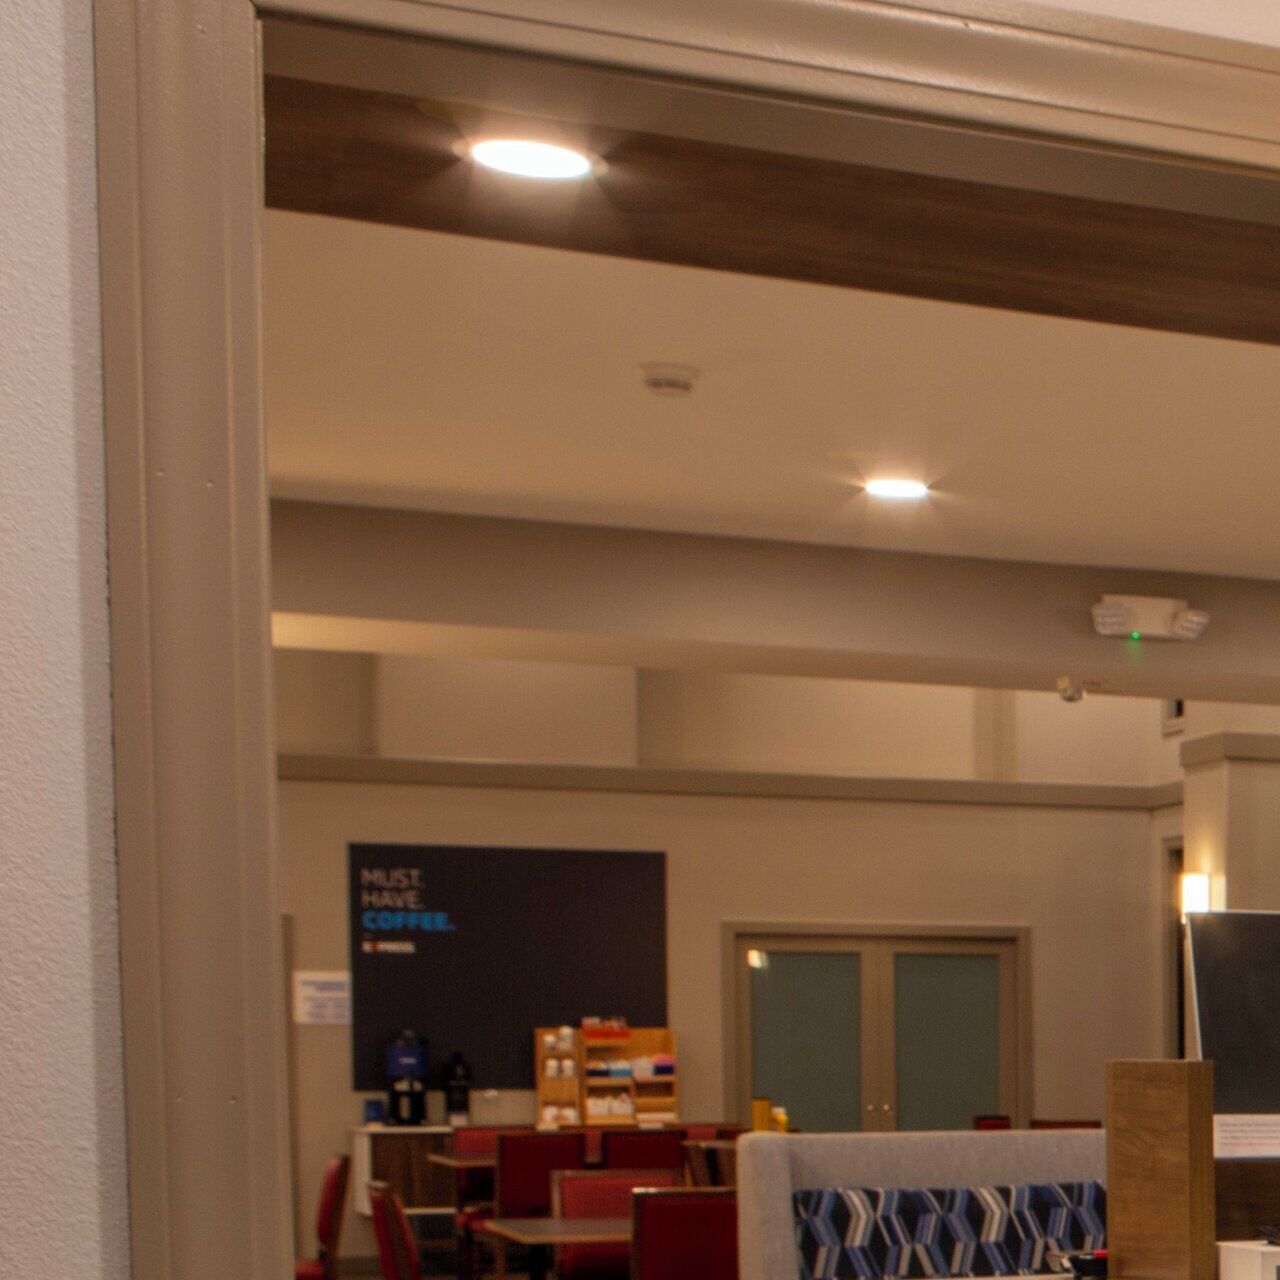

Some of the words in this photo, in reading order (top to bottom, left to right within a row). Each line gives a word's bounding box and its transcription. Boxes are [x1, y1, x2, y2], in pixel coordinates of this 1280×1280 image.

[360, 868, 426, 890] MUST.
[360, 889, 426, 910] HAVE.
[362, 911, 456, 931] COFFEE.
